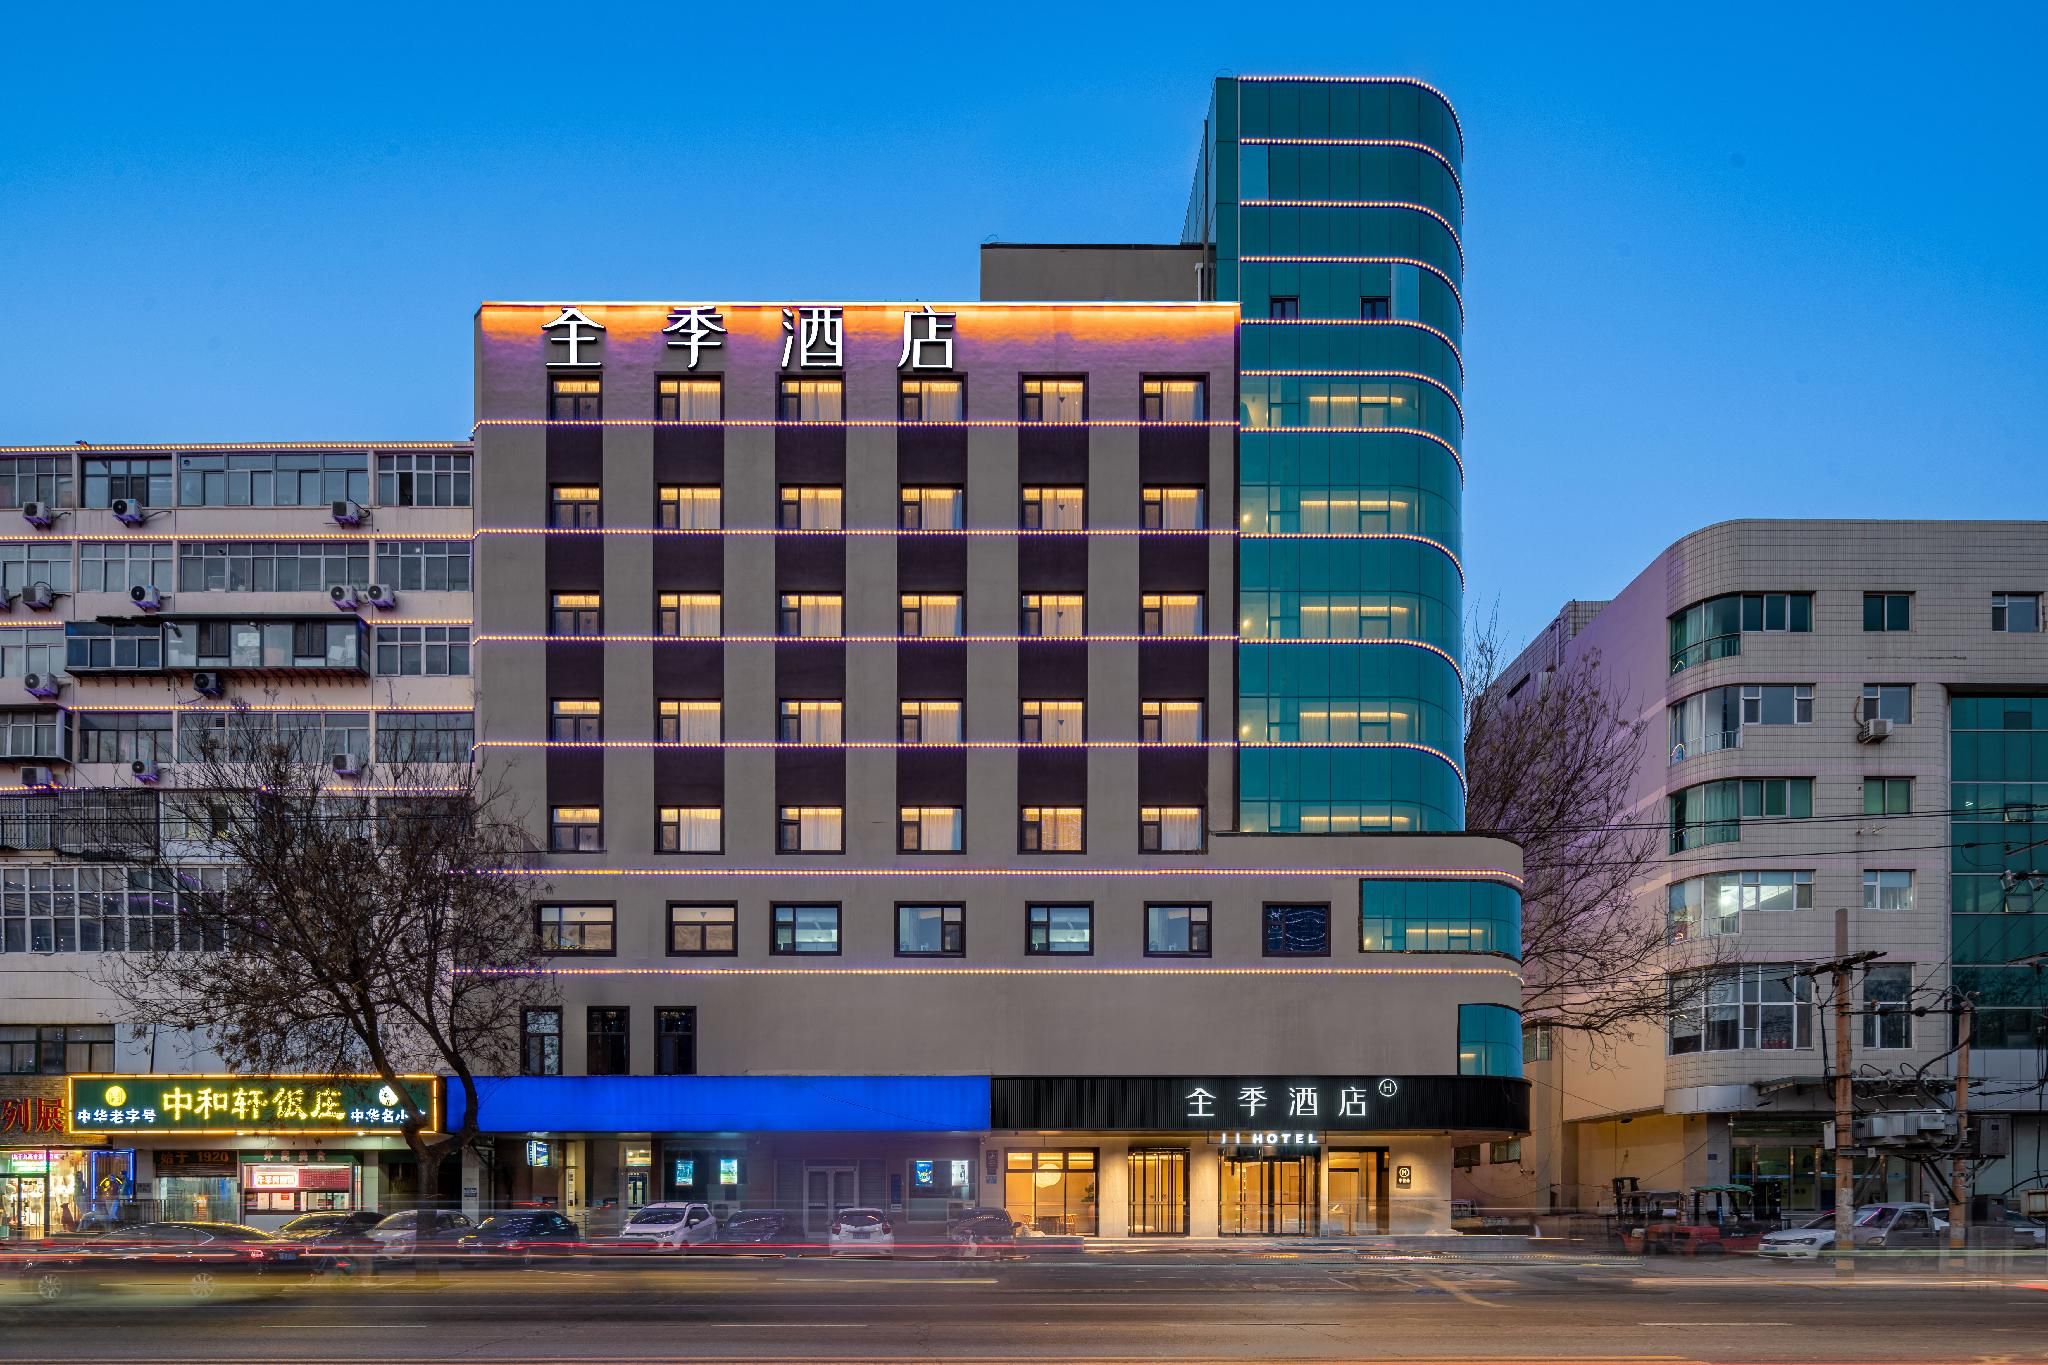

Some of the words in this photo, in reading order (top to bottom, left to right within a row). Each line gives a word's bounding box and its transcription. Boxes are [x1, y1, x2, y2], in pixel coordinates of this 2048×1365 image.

[542, 306, 958, 370] 全季酒店
[162, 1087, 346, 1120] 中和轩饭庄
[1185, 1086, 1367, 1117] 全季酒店
[77, 1109, 157, 1124] 中华老字号
[350, 1108, 426, 1124] 中华名小
[1252, 1132, 1318, 1144] HOTEL
[197, 1151, 229, 1163] 1920
